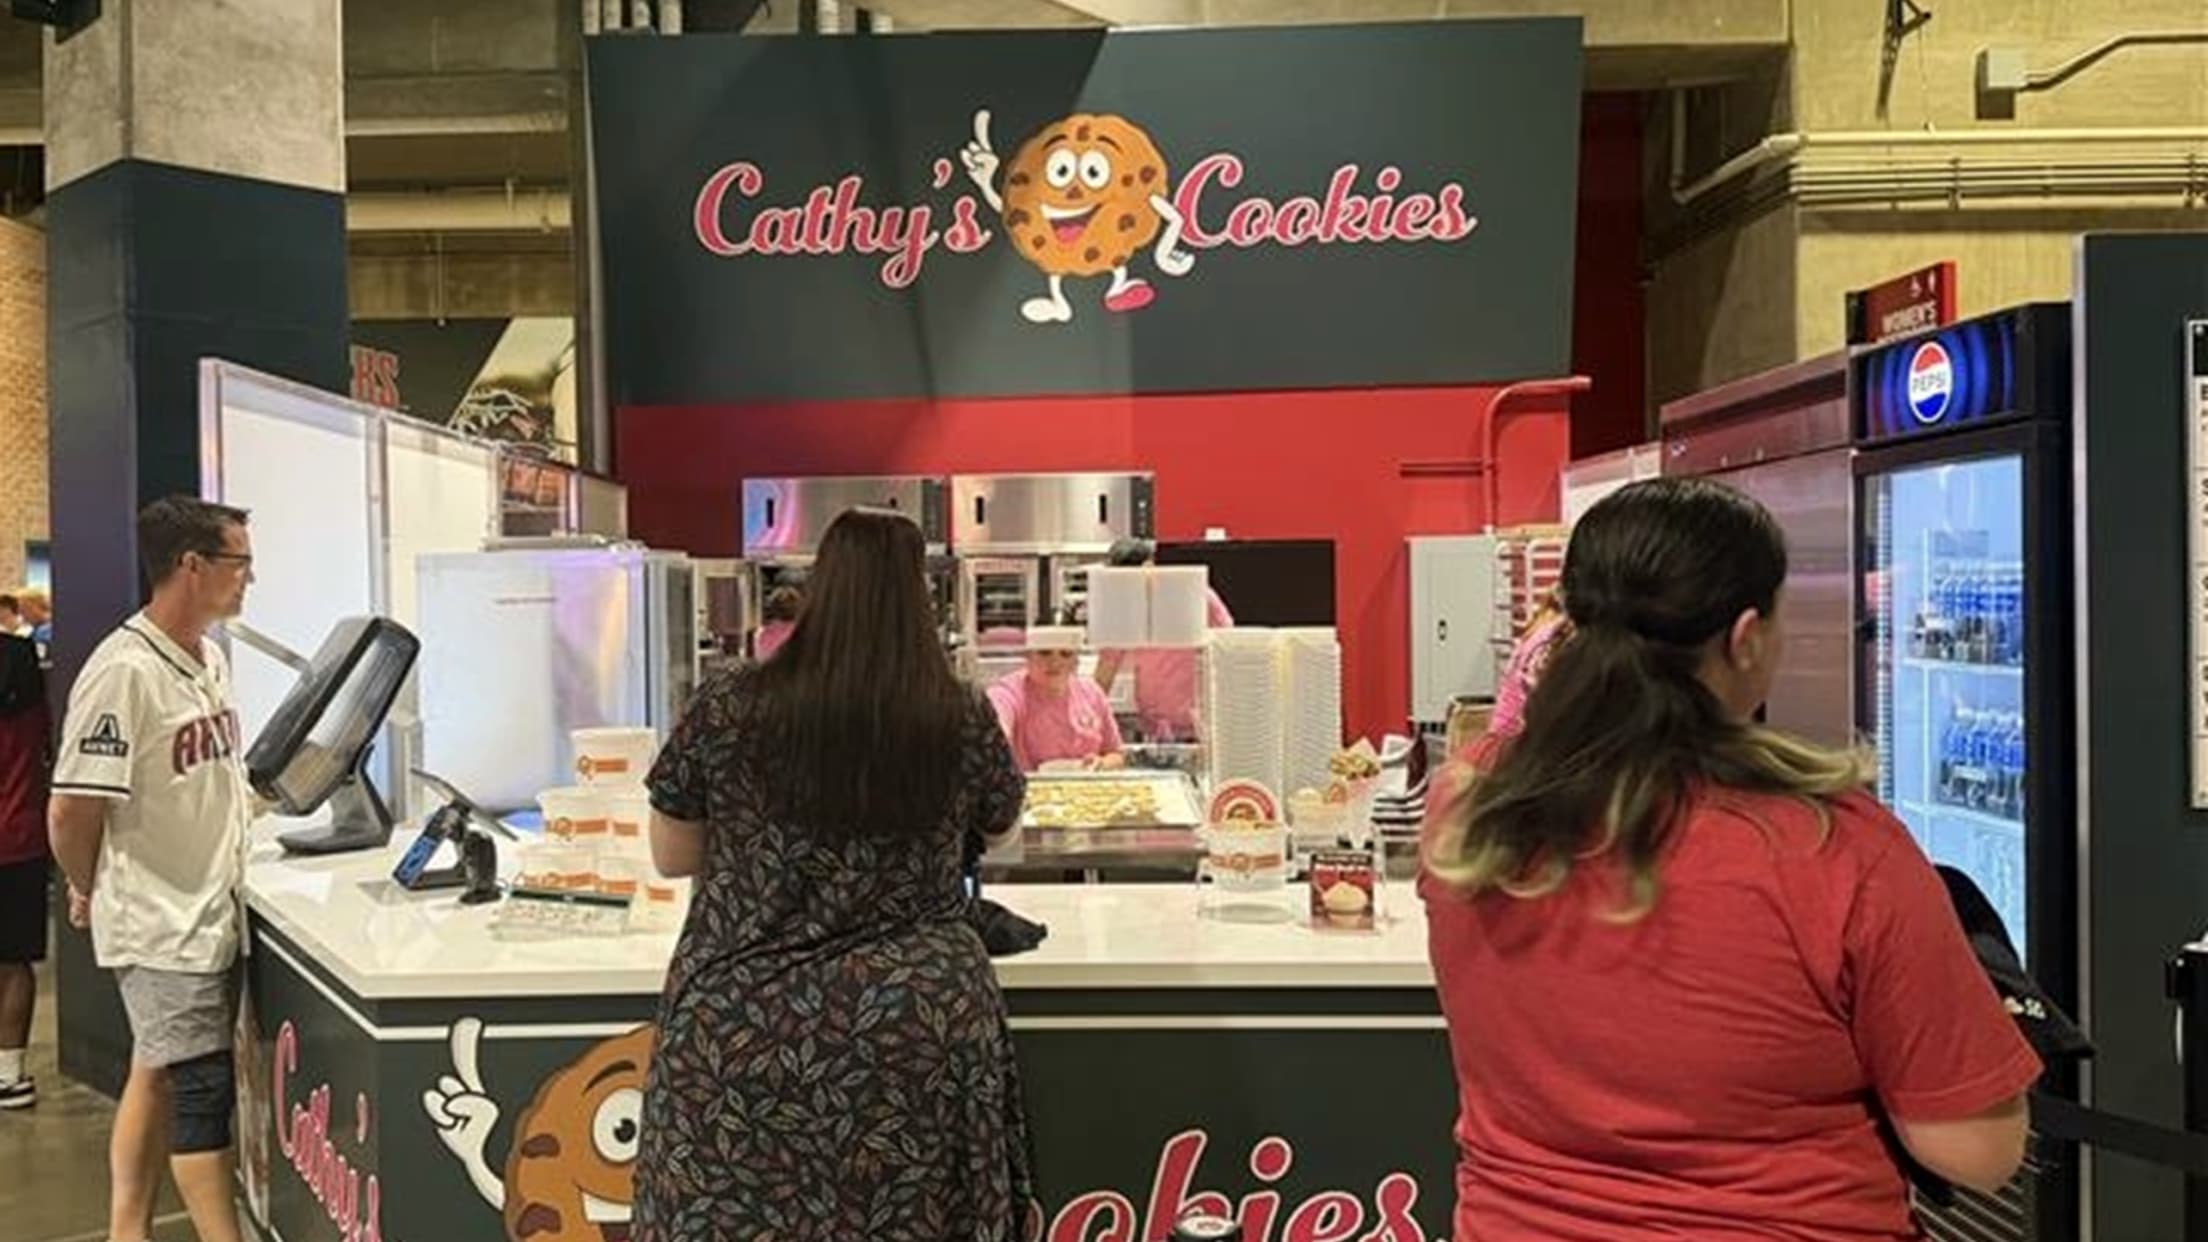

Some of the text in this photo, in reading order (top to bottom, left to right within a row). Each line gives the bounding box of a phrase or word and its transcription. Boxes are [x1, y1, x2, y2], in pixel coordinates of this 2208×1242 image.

[693, 153, 1478, 288] Cathy's Cookies
[1911, 371, 1948, 393] PEPSI
[1028, 1129, 1442, 1242] okies
